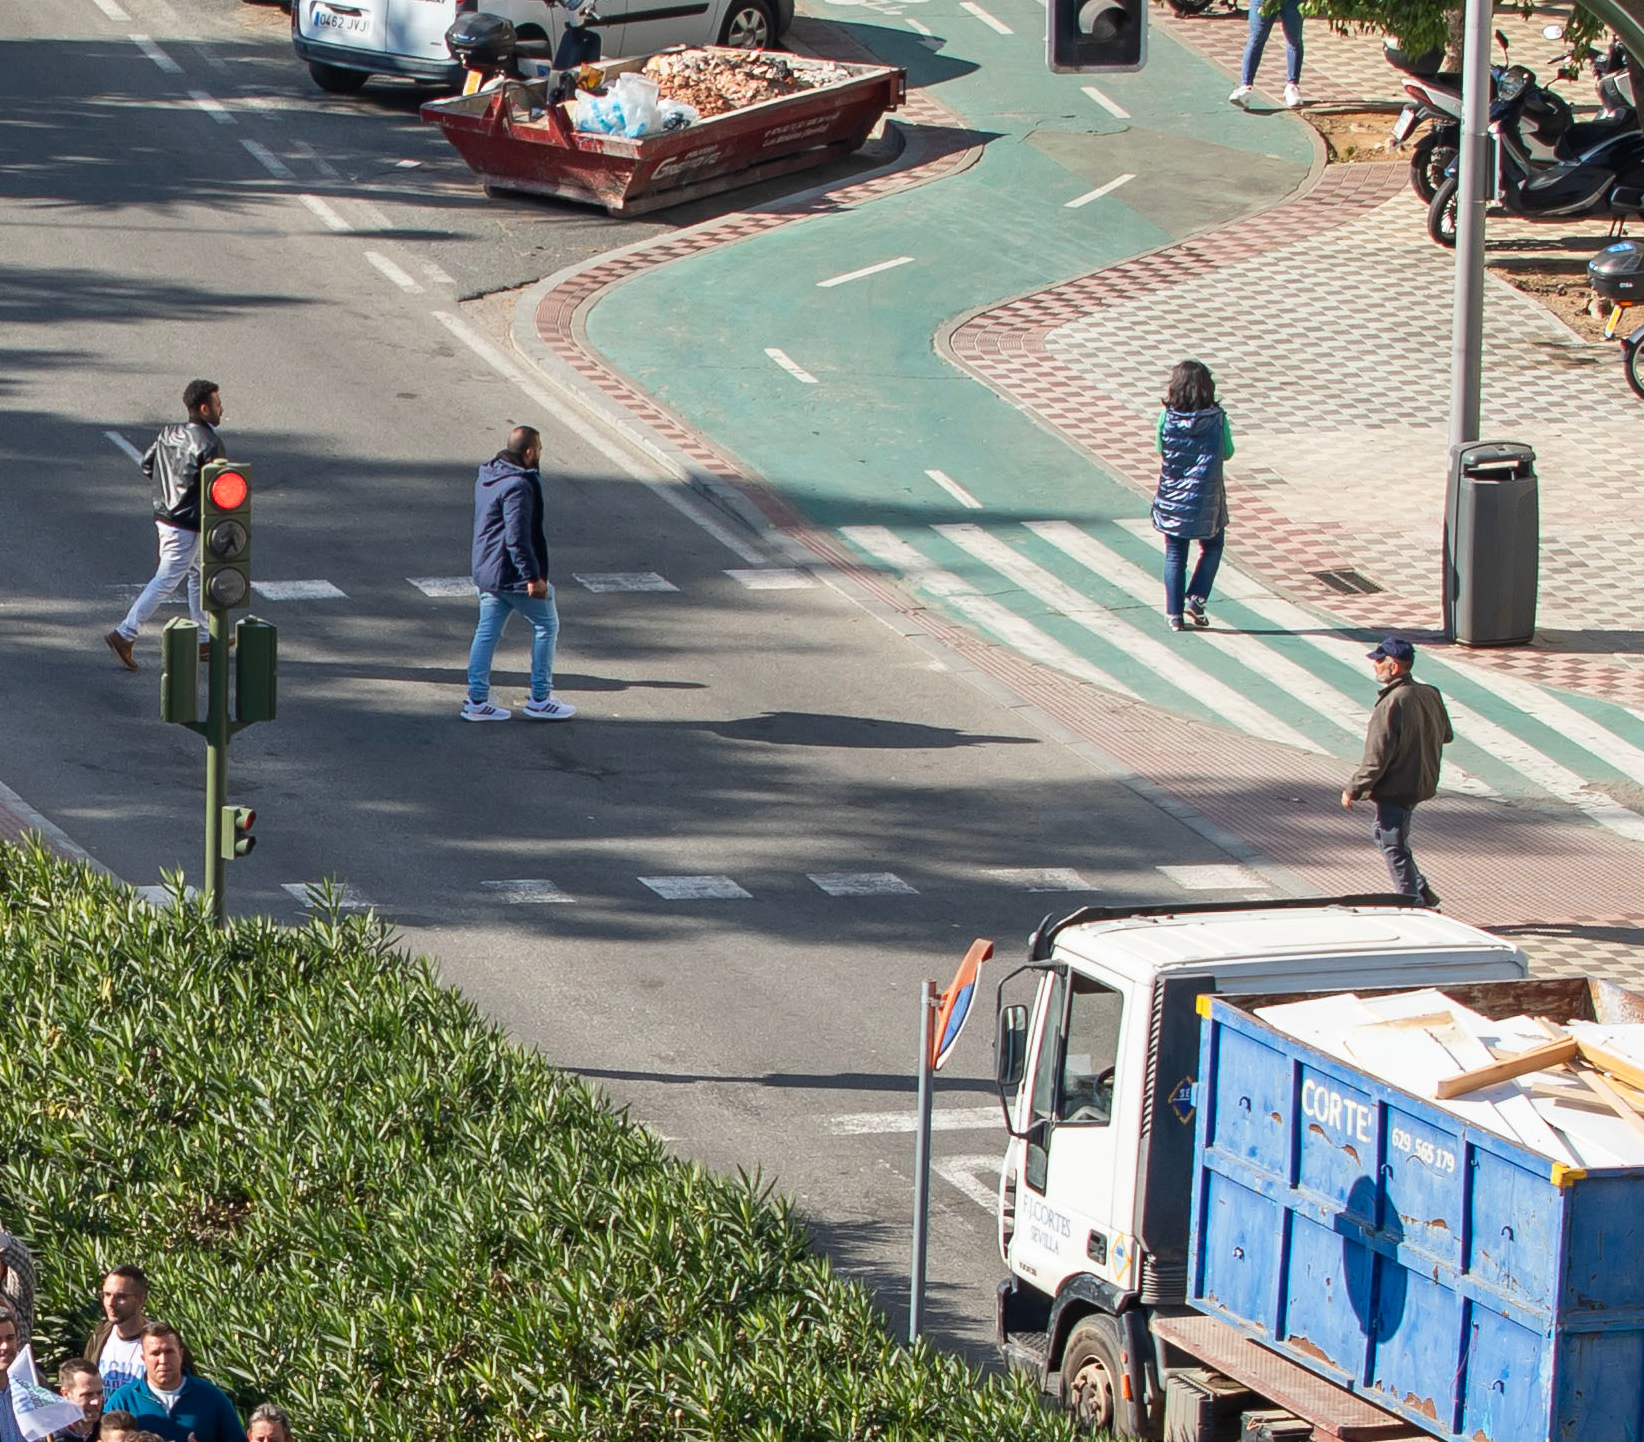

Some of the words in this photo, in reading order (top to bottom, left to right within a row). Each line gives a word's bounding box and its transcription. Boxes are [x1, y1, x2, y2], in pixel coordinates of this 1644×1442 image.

[1392, 1128, 1411, 1151] 629
[1415, 1137, 1435, 1164] 565
[1436, 1148, 1456, 1173] 179
